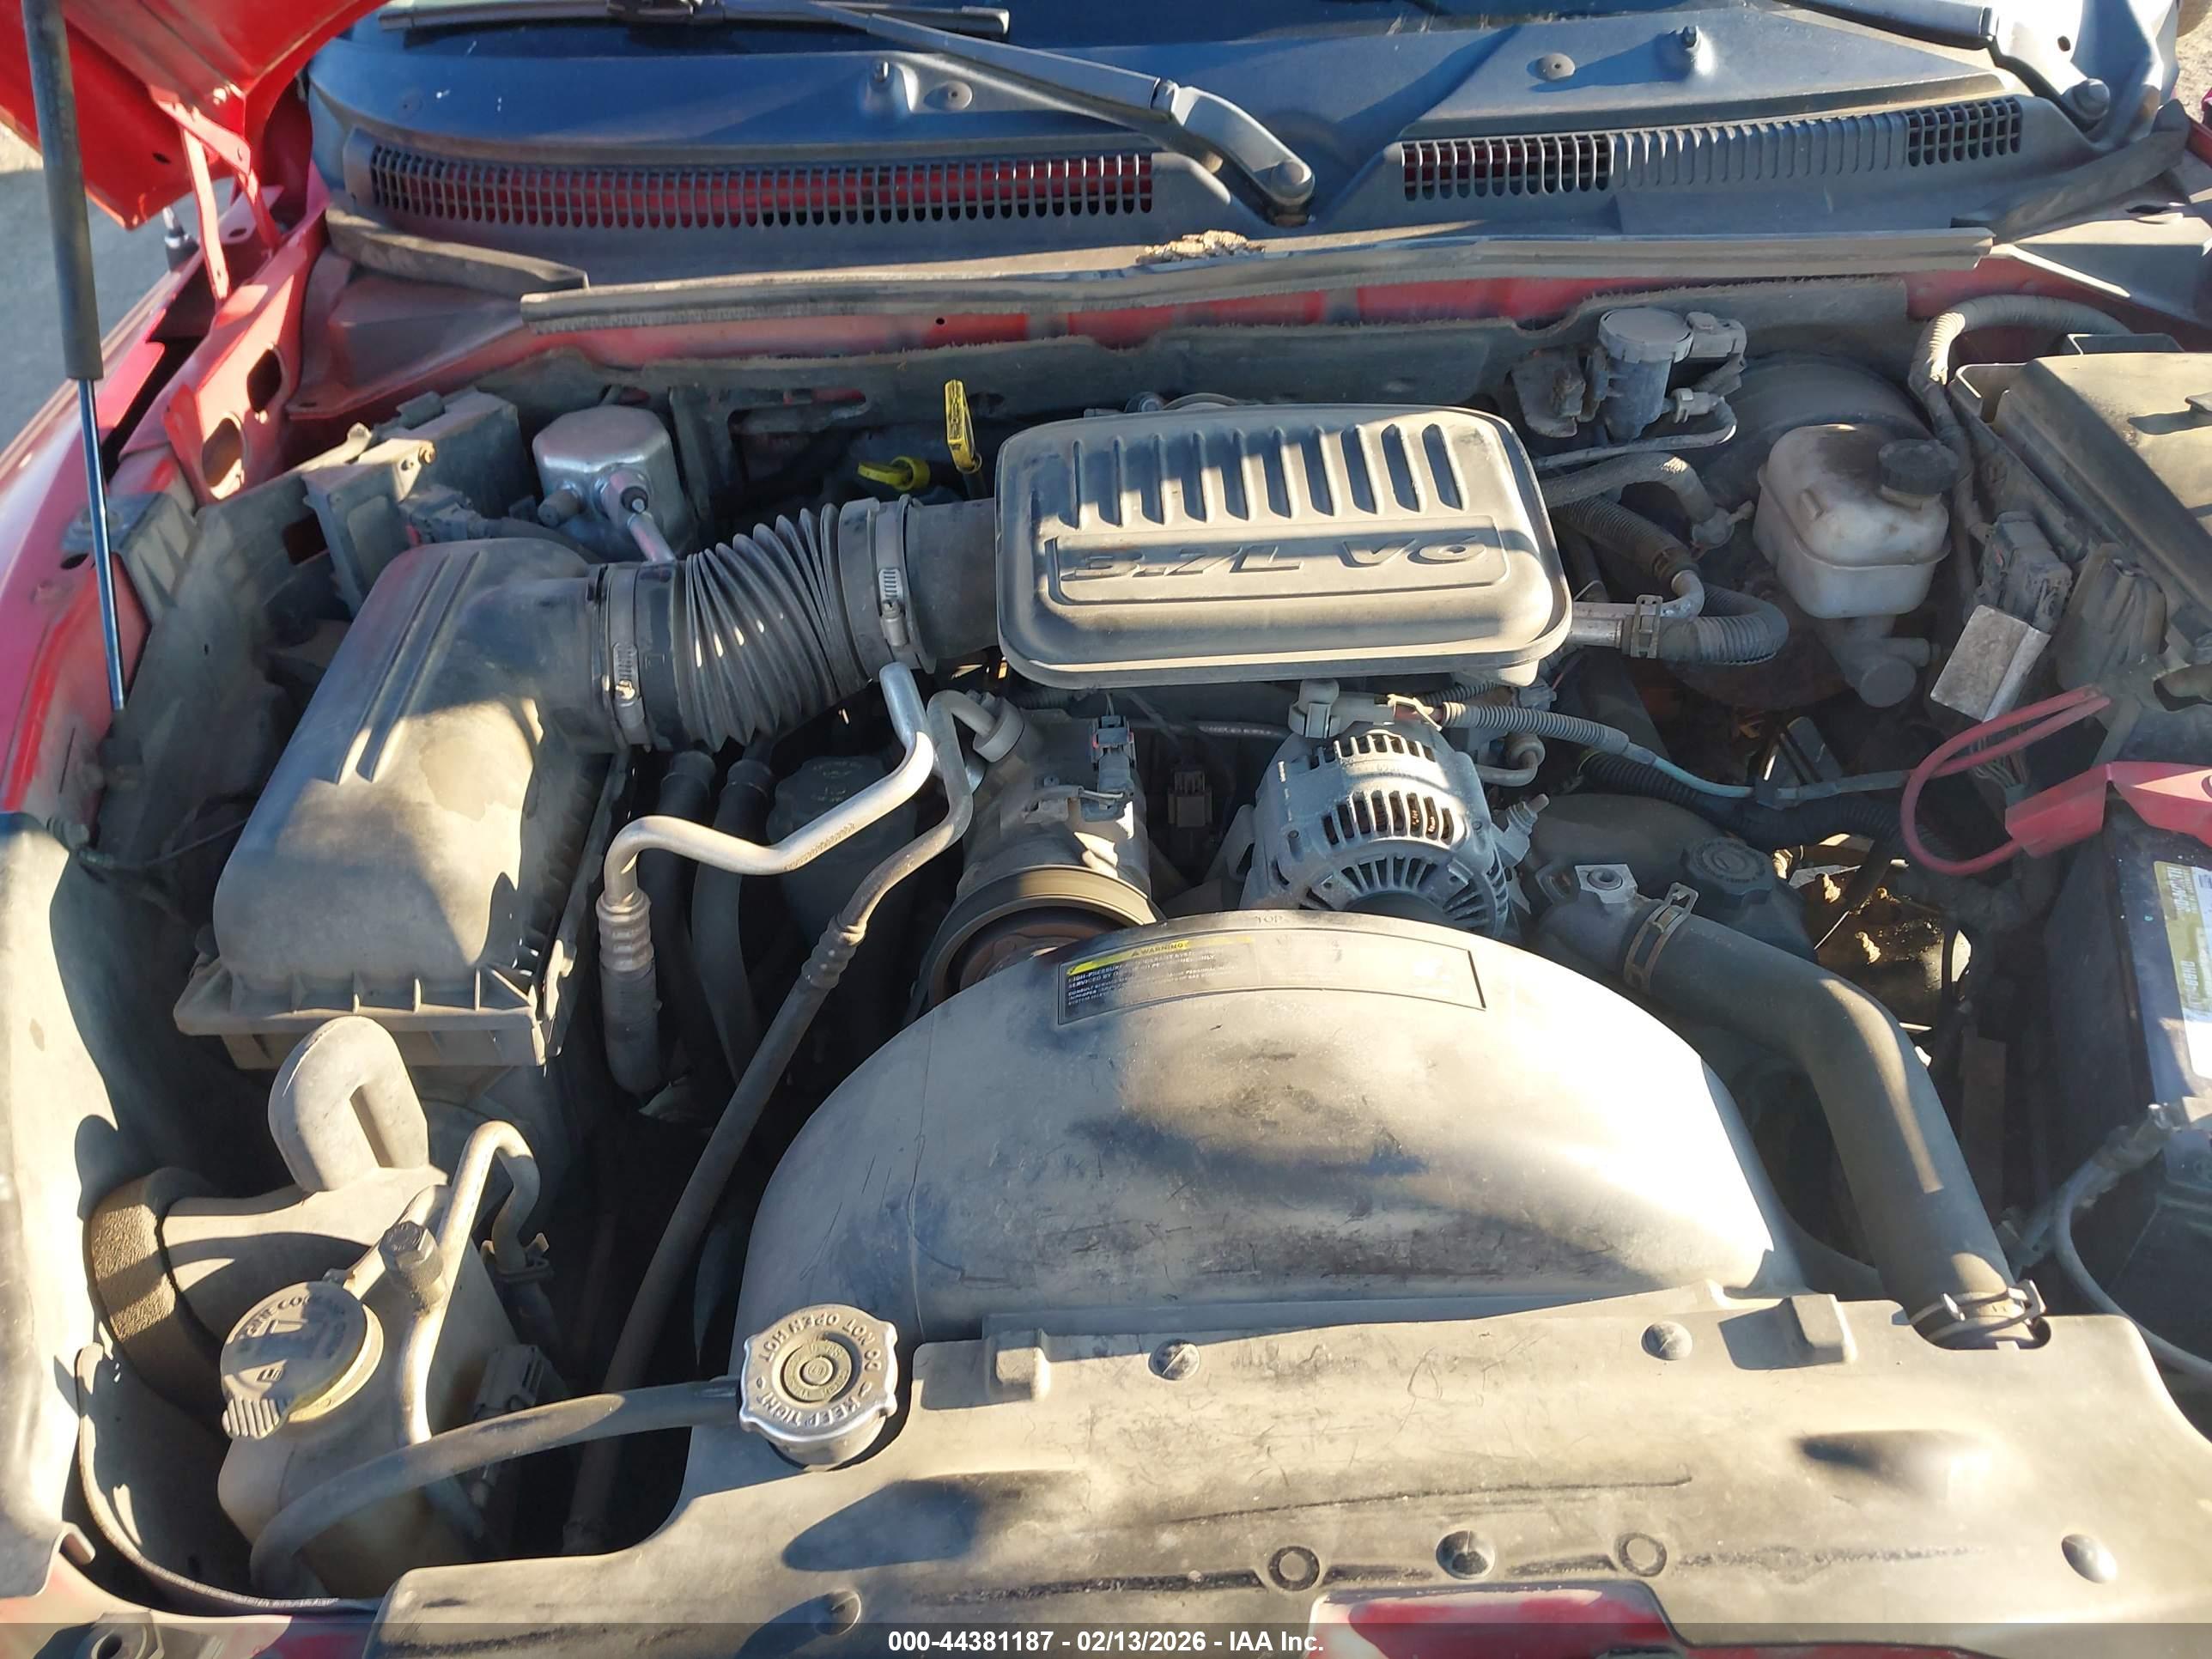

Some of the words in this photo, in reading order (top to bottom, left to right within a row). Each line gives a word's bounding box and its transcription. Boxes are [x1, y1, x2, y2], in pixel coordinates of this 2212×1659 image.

[1338, 534, 1486, 568] V6
[1255, 915, 1284, 924] TOP
[1140, 943, 1184, 955] WARNING
[787, 1311, 840, 1334] OPEN
[842, 1318, 877, 1346] NOT
[759, 1330, 790, 1362] HOT
[805, 1396, 860, 1427] KEEP
